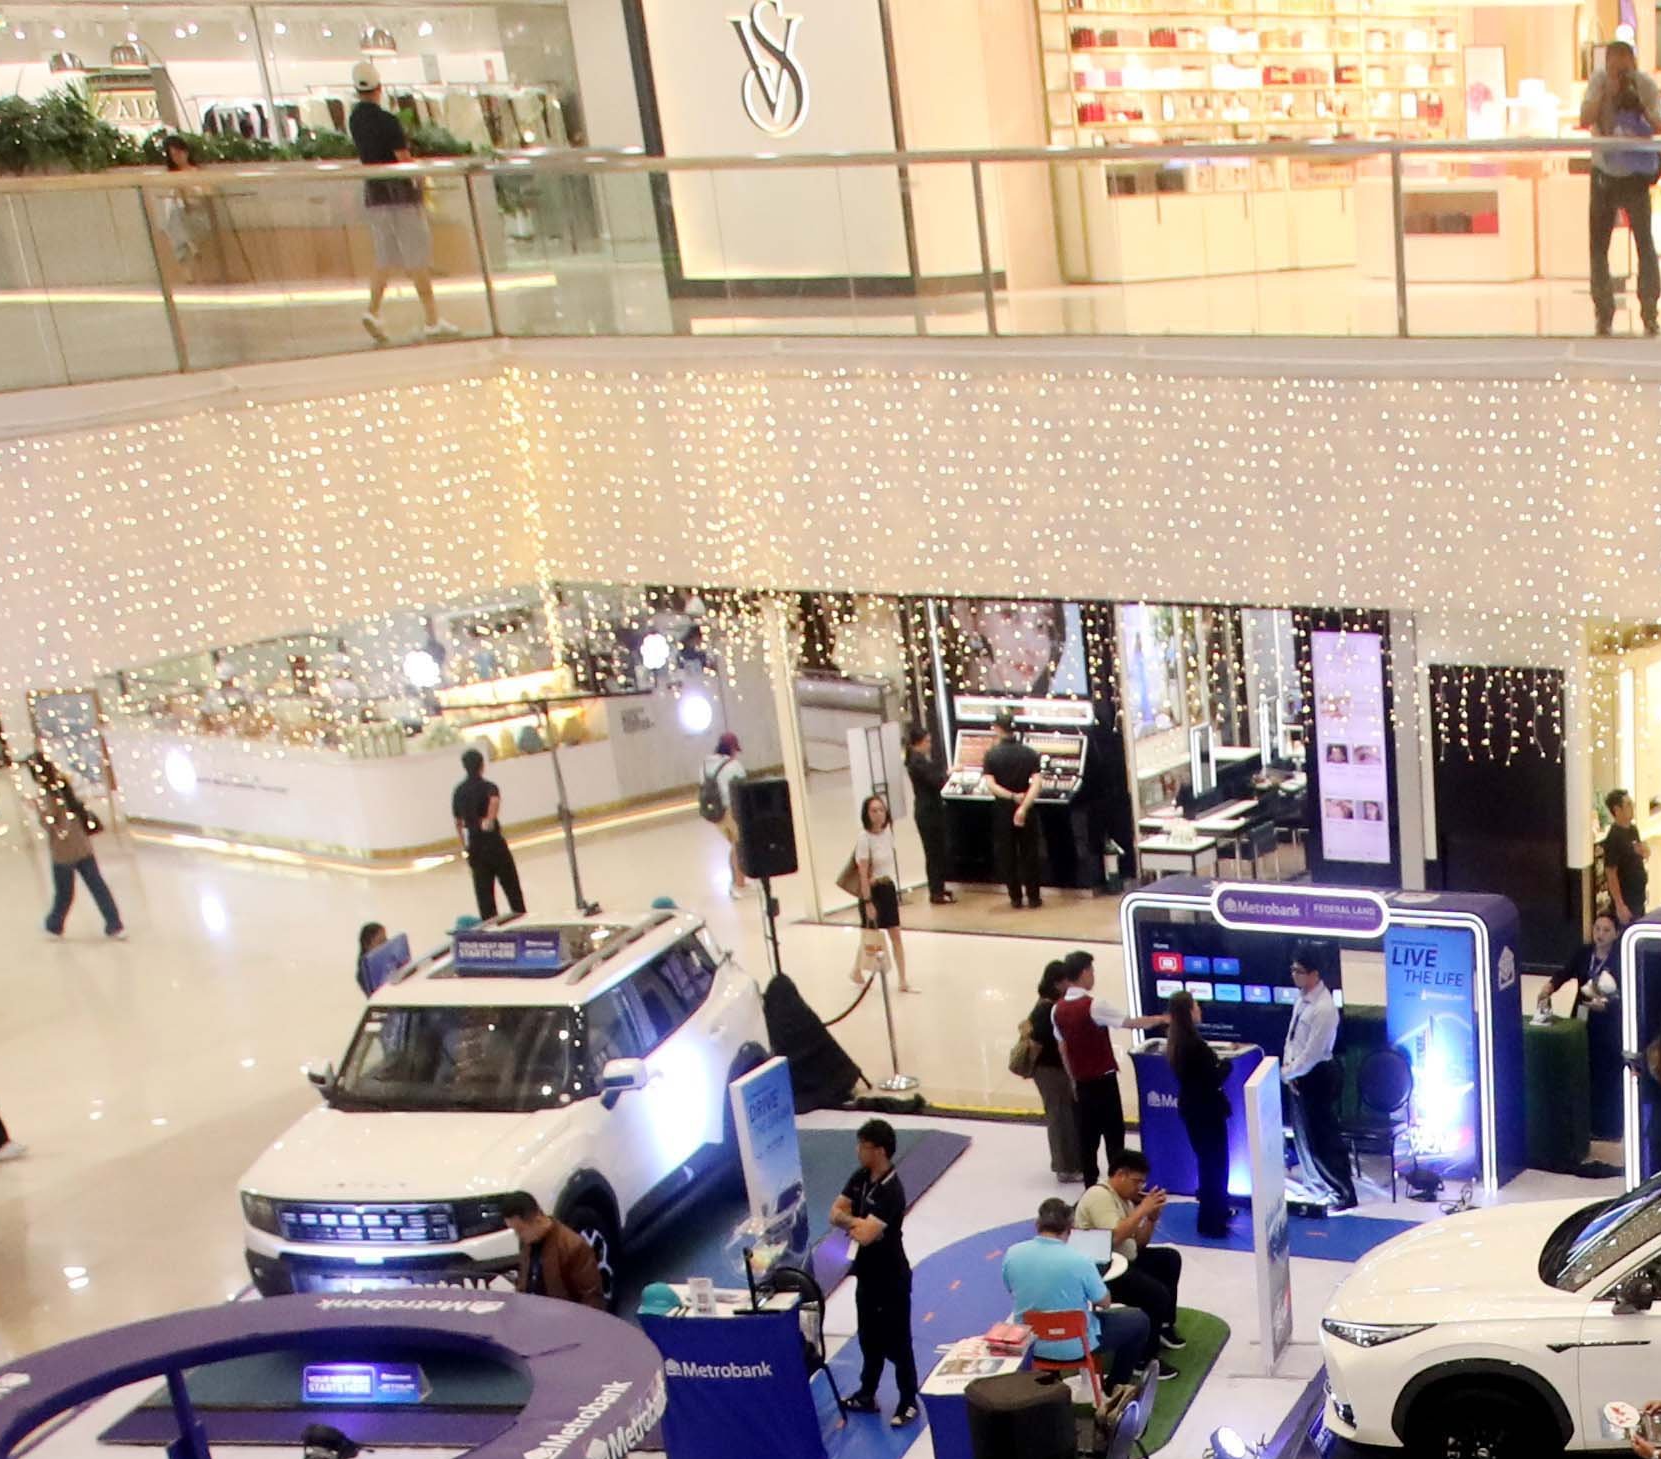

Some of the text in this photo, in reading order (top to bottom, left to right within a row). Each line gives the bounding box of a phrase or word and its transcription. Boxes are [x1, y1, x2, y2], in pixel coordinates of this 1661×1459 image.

[1238, 901, 1376, 918] Metrobank FEDERAL LAND
[1392, 946, 1438, 968] LIVE
[1404, 969, 1465, 987] THE LIFE
[682, 1360, 772, 1378] Metrobank
[542, 1380, 634, 1456] Metrobank
